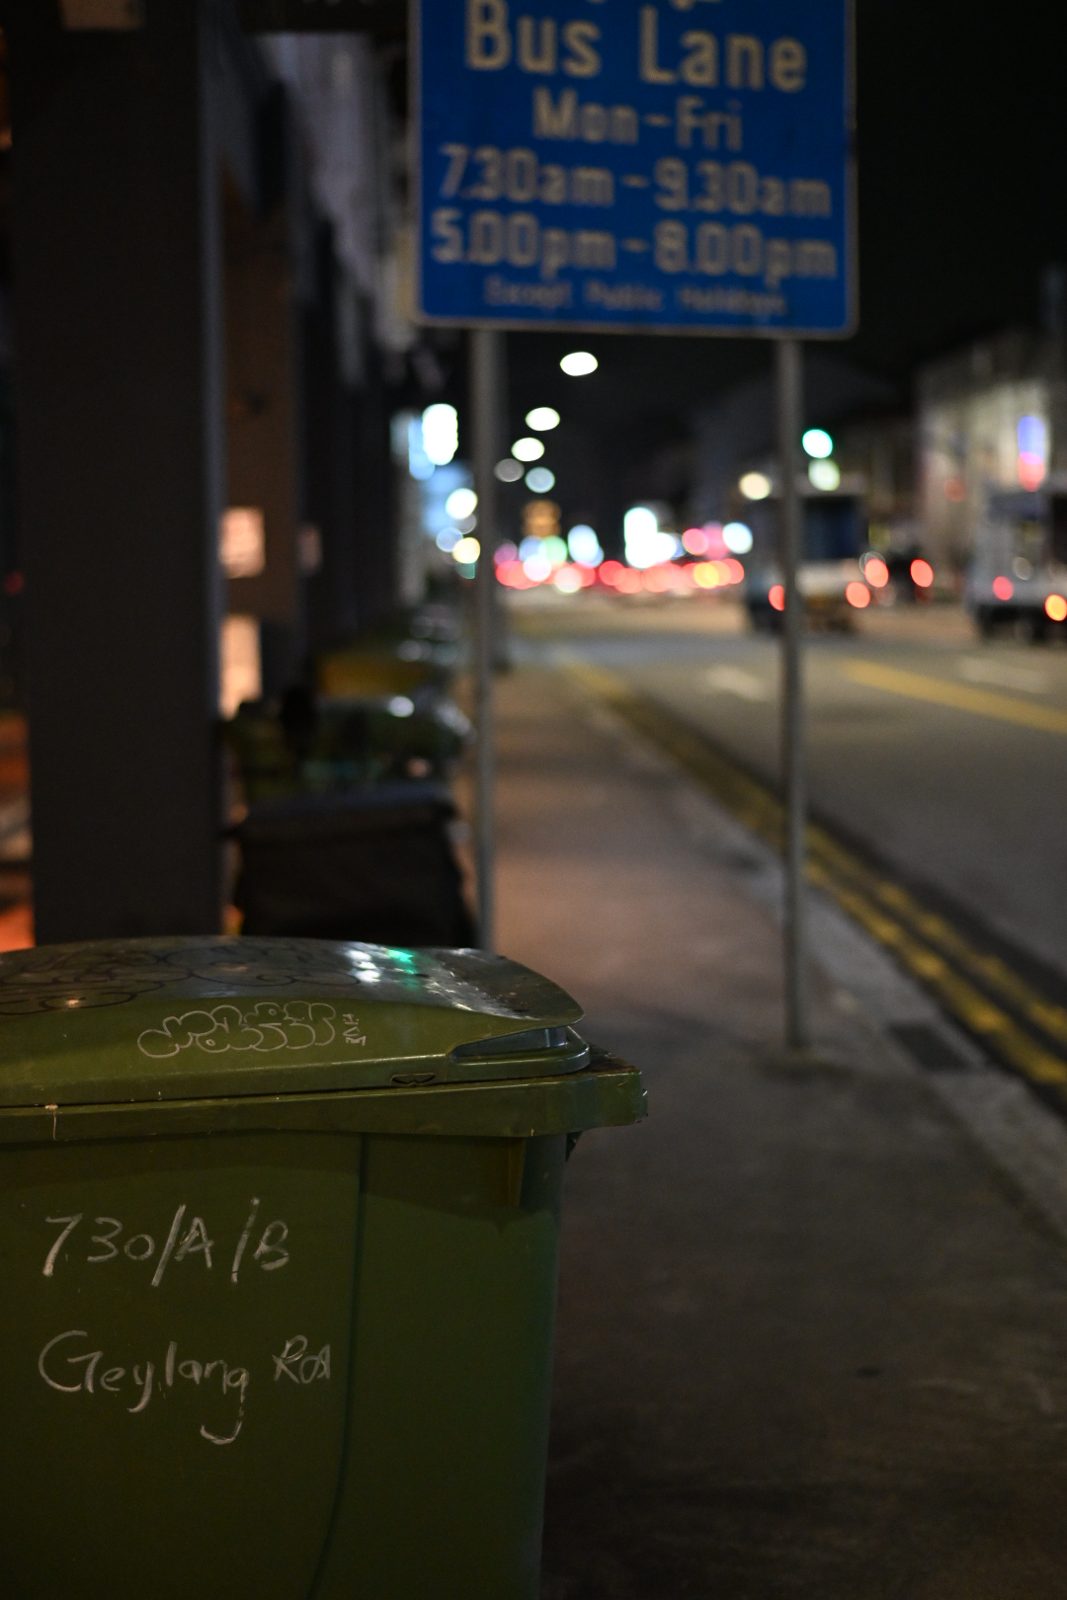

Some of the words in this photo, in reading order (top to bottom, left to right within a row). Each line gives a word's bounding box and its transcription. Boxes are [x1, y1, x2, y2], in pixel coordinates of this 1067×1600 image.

[465, 0, 601, 78] Bus
[638, 4, 807, 92] Lane
[37, 1329, 250, 1446] Geylang
